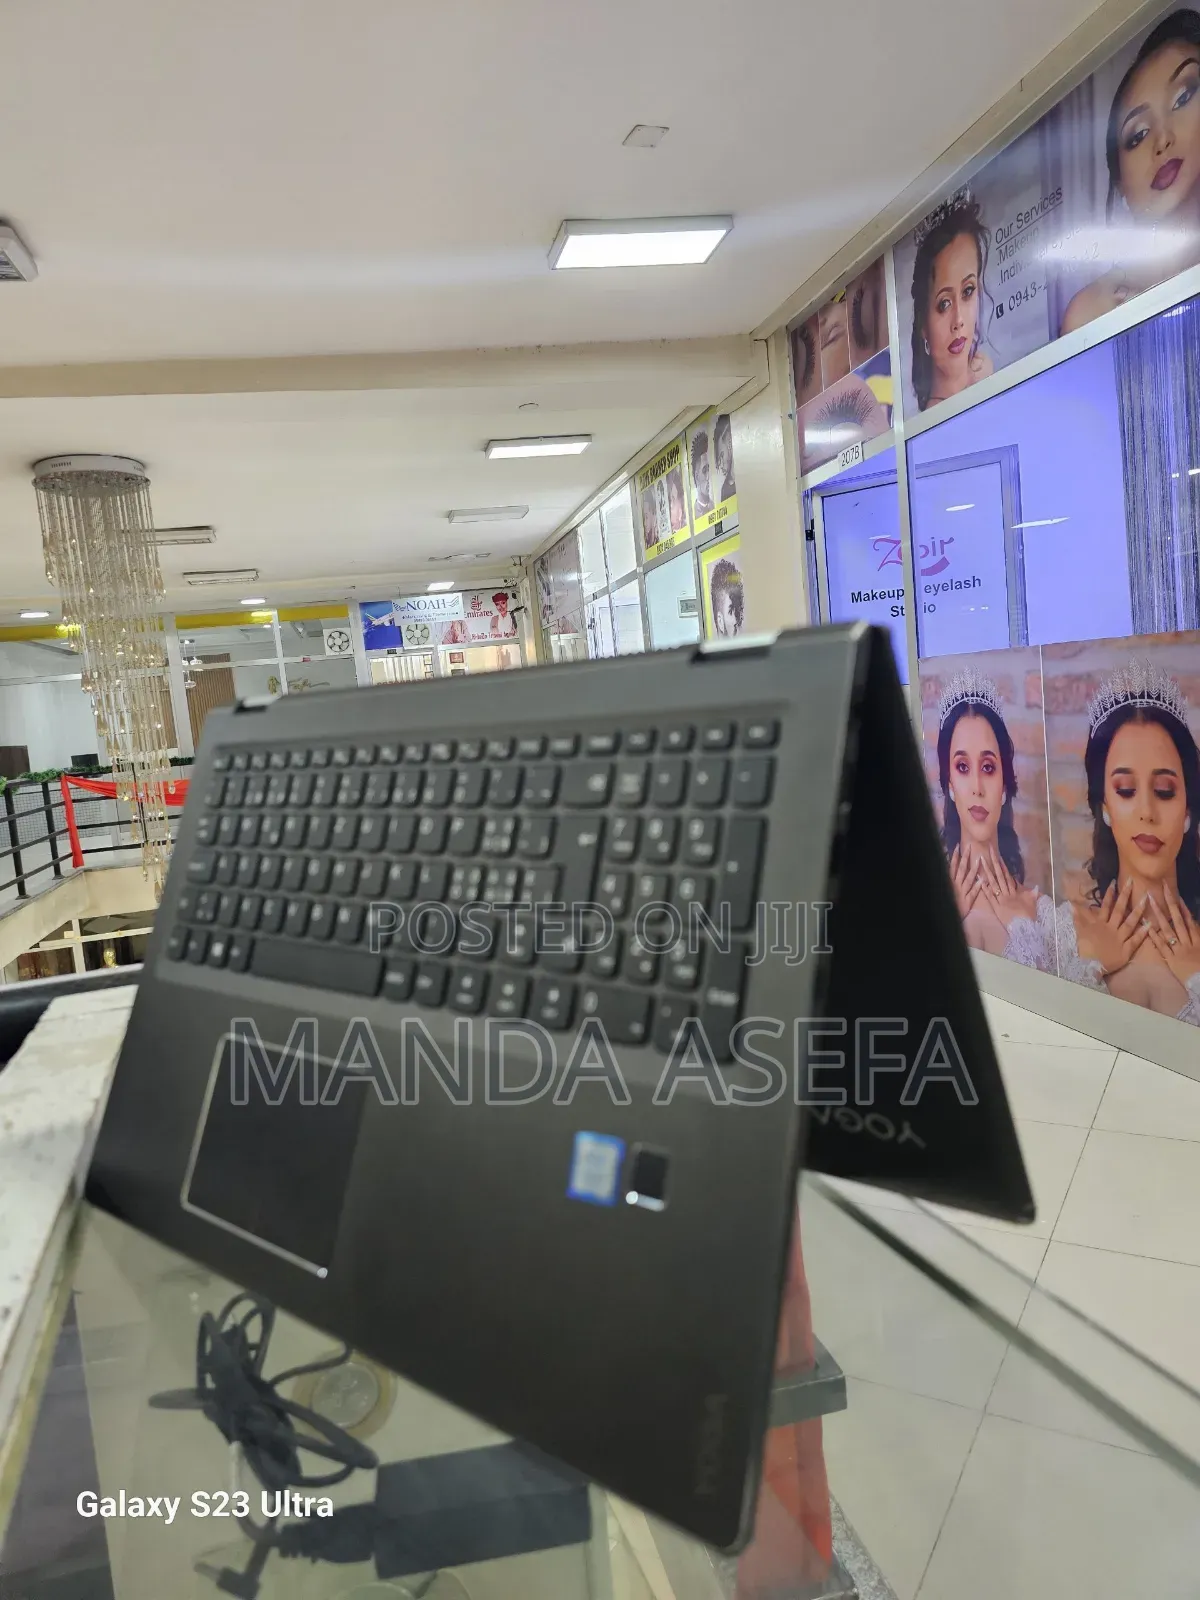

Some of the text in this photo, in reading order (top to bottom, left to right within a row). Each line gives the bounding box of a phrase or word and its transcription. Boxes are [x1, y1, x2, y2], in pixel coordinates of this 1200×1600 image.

[995, 222, 1014, 244] Our
[1016, 187, 1063, 230] Services
[841, 445, 860, 467] 207B
[851, 576, 982, 604] Makeup eyelash
[406, 598, 447, 611] NOAH
[890, 602, 936, 618] Stio
